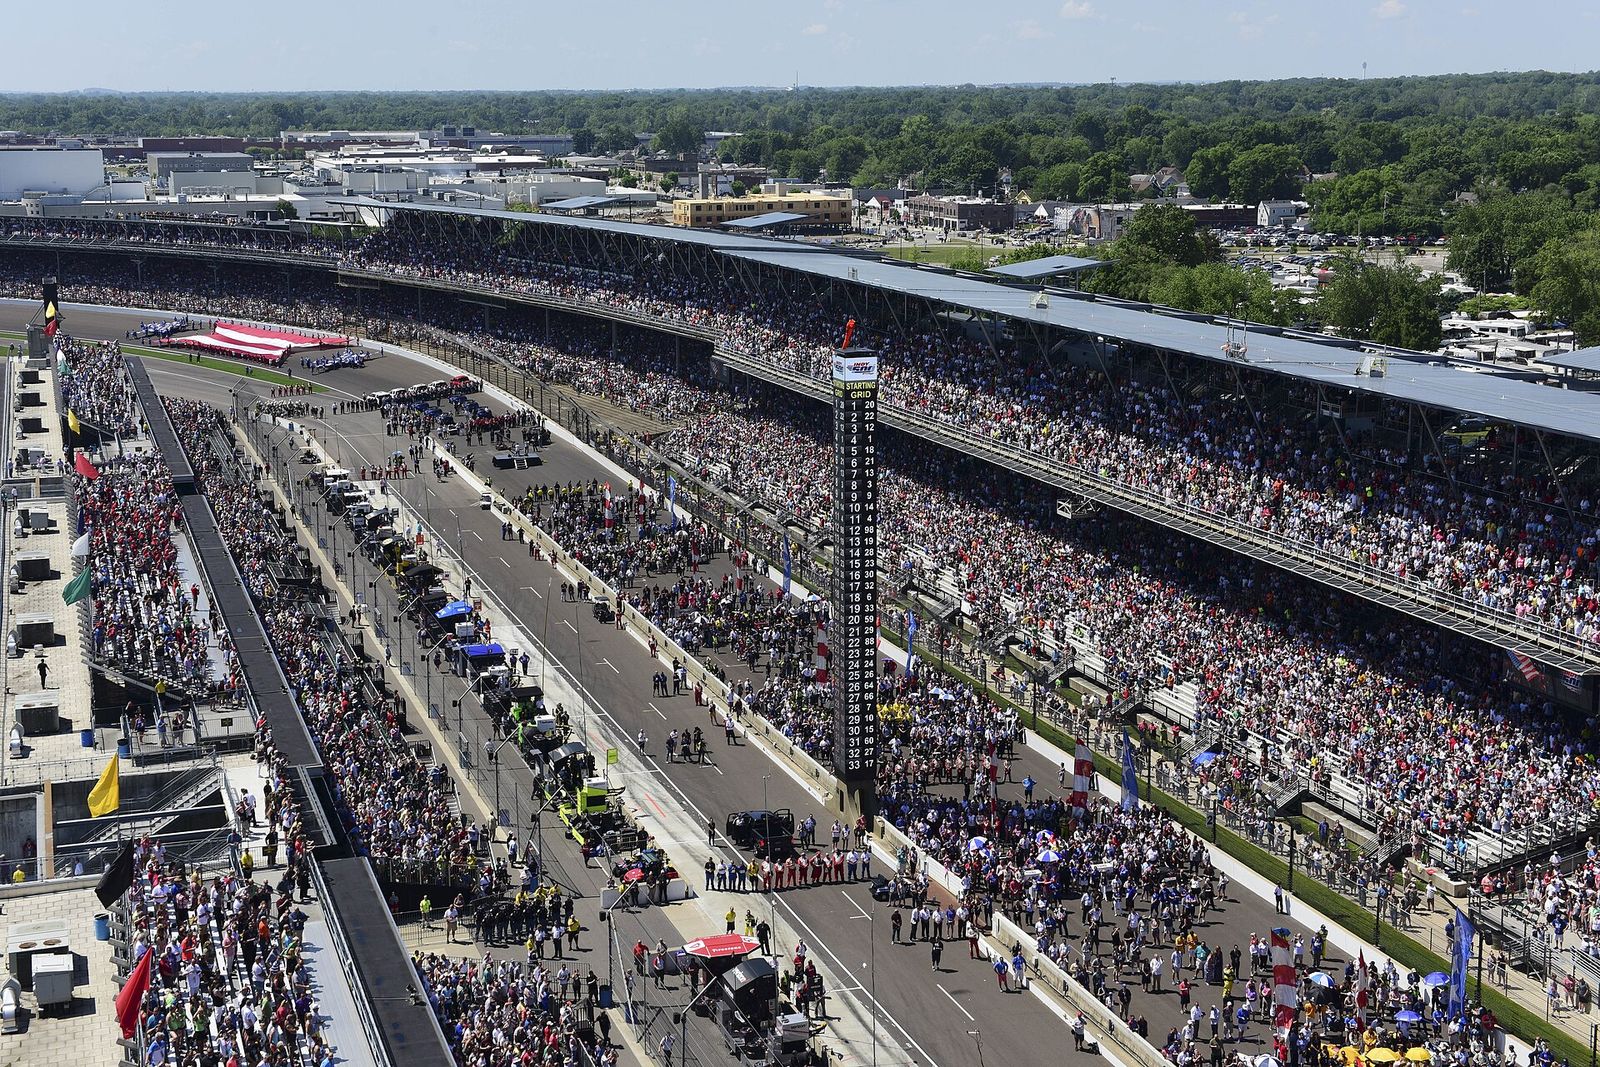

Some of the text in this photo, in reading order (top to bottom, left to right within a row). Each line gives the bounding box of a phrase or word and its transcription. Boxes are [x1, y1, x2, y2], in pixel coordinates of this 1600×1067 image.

[846, 382, 876, 390] STARTING
[851, 401, 856, 410] 1
[851, 412, 874, 422] 2 22
[851, 423, 874, 433] 3 12
[851, 436, 857, 444] 4
[851, 447, 857, 456] 5
[851, 457, 874, 467] 6 21
[851, 470, 857, 478] 7
[851, 481, 857, 490] 8
[851, 493, 857, 501] 9
[849, 503, 873, 512] 10 14
[849, 514, 860, 524] 11
[850, 526, 860, 535] 12
[849, 537, 873, 546] 13 19
[849, 548, 874, 557] 14 28
[850, 559, 874, 568] 15 23
[850, 570, 874, 580] 16 30
[850, 582, 860, 591] 17
[850, 593, 860, 602] 18
[849, 604, 874, 613] 19 33
[848, 615, 874, 624] 20 59
[849, 626, 874, 636] 21 29
[848, 638, 860, 647] 22
[848, 648, 874, 658] 23 25
[848, 660, 859, 669] 24
[848, 670, 874, 680] 25 26
[848, 682, 860, 692] 26
[849, 693, 860, 702] 27
[849, 704, 860, 713] 28
[849, 715, 860, 724] 29
[849, 725, 874, 735] 30 15
[849, 737, 859, 747] 31
[849, 748, 873, 758] 32 27
[849, 760, 860, 769] 33
[1206, 815, 1213, 825] 2
